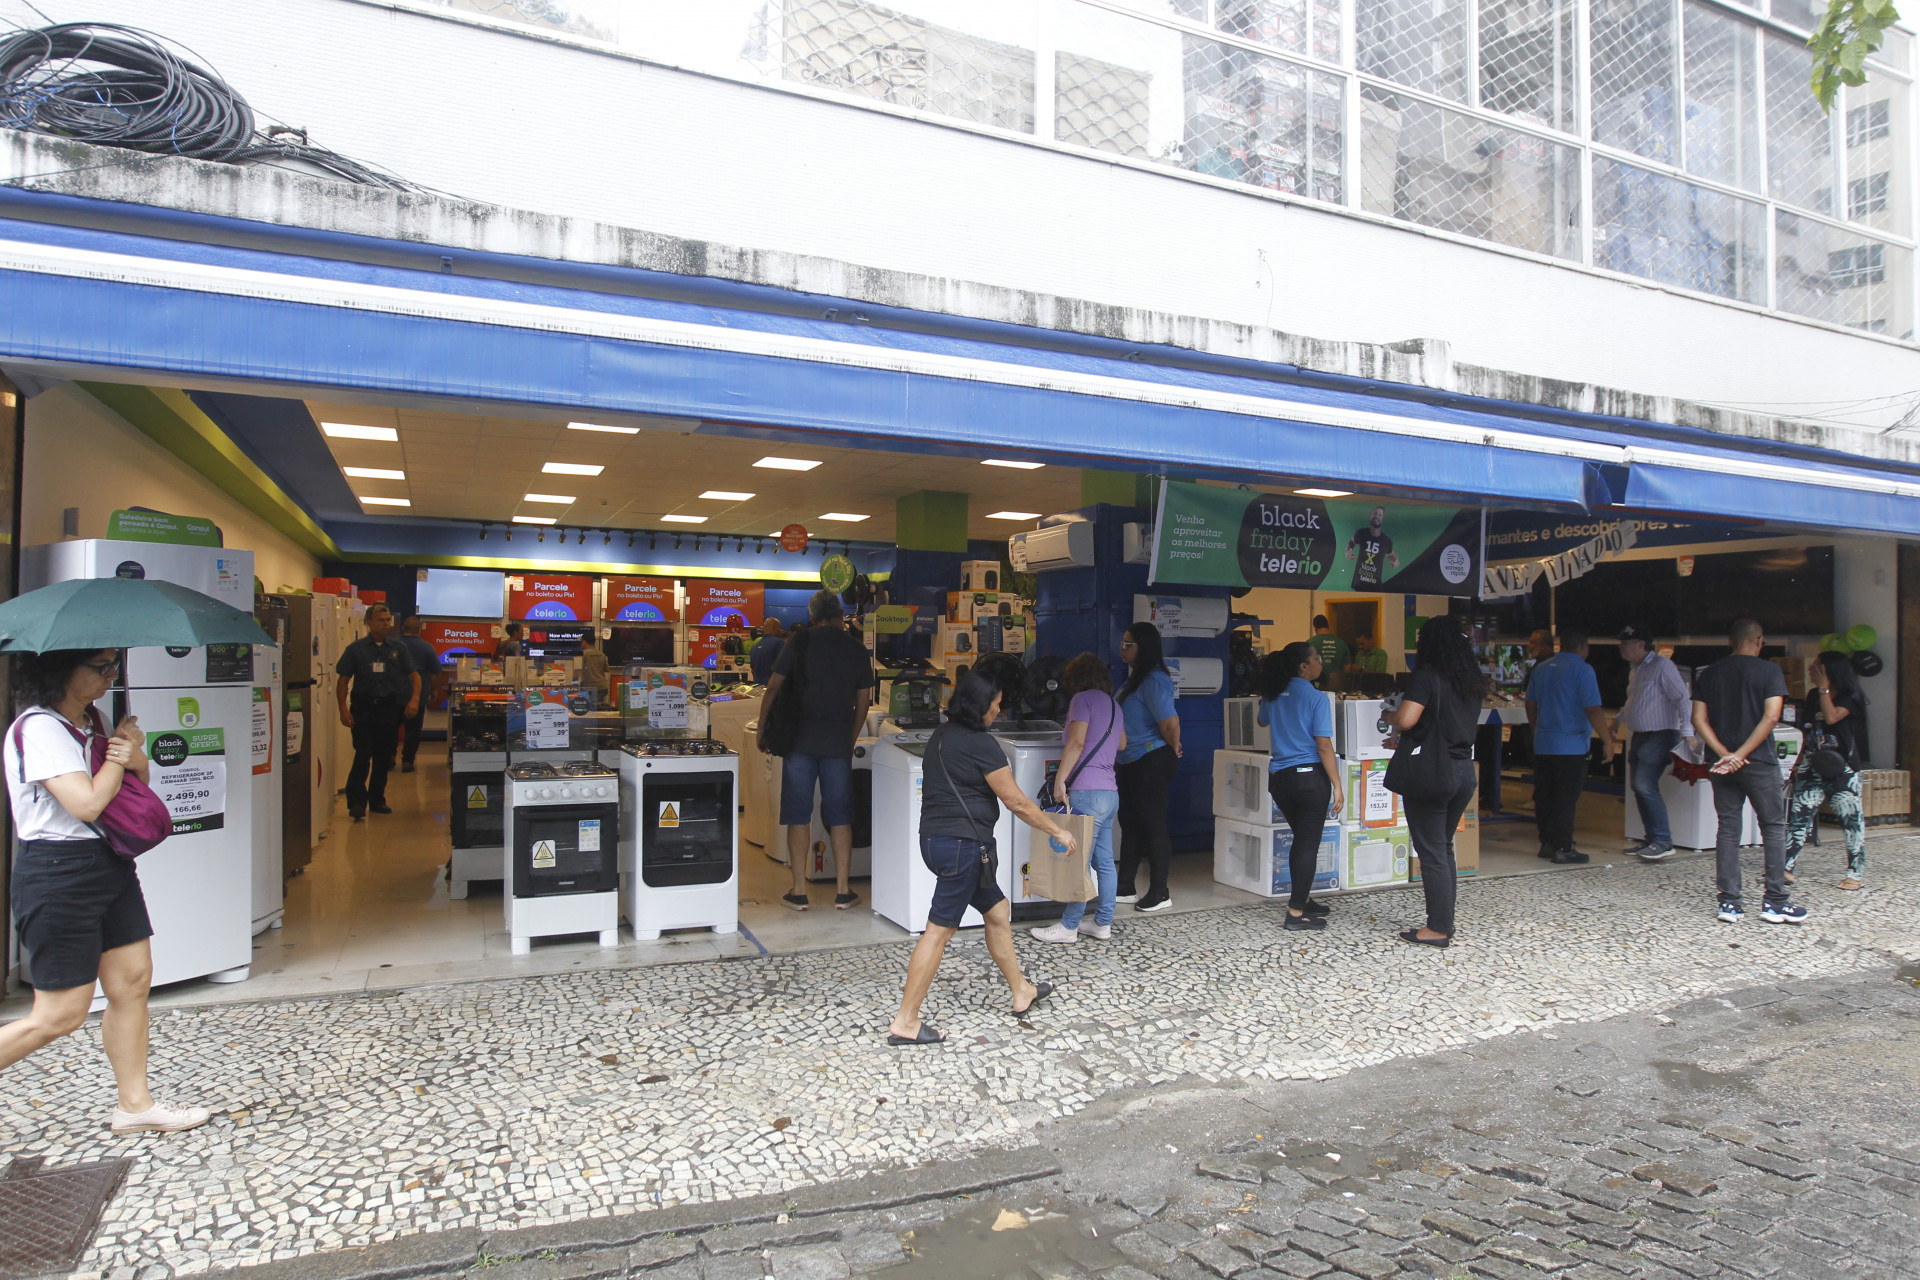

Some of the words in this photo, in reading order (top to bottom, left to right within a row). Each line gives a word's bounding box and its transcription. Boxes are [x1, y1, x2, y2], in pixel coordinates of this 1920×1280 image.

[119, 513, 152, 522] Geladeira
[1176, 514, 1204, 525] Venha
[1260, 504, 1320, 529] black
[119, 520, 149, 528] pensada
[187, 524, 210, 533] Consul
[1173, 526, 1223, 538] aproveitar
[1541, 530, 1550, 540] e
[1184, 538, 1227, 549] melhores
[1250, 528, 1314, 556] friday
[1366, 541, 1380, 554] 15
[1170, 550, 1204, 560] preços!
[1365, 552, 1376, 565] X
[1260, 553, 1321, 575] telerio
[1361, 563, 1377, 572] black
[1360, 575, 1376, 584] telerio
[534, 582, 569, 591] Parcele
[625, 584, 657, 593] Parcele
[709, 587, 741, 597] Parcele
[535, 608, 567, 618] telerio
[625, 609, 656, 619] telerio
[710, 614, 727, 623] tele
[876, 615, 909, 624] Cooktops
[444, 629, 478, 638] Parcele
[193, 734, 218, 742] SUPER
[159, 739, 183, 747] black
[190, 741, 220, 749] OFERTA
[252, 744, 267, 753] 53,32
[160, 752, 184, 760] telerio
[161, 771, 205, 780] REFRIGERADOR
[166, 790, 210, 801] 2.499,90
[174, 804, 202, 813] 166,66
[173, 822, 202, 832] telerio
[1390, 827, 1408, 836] Consul
